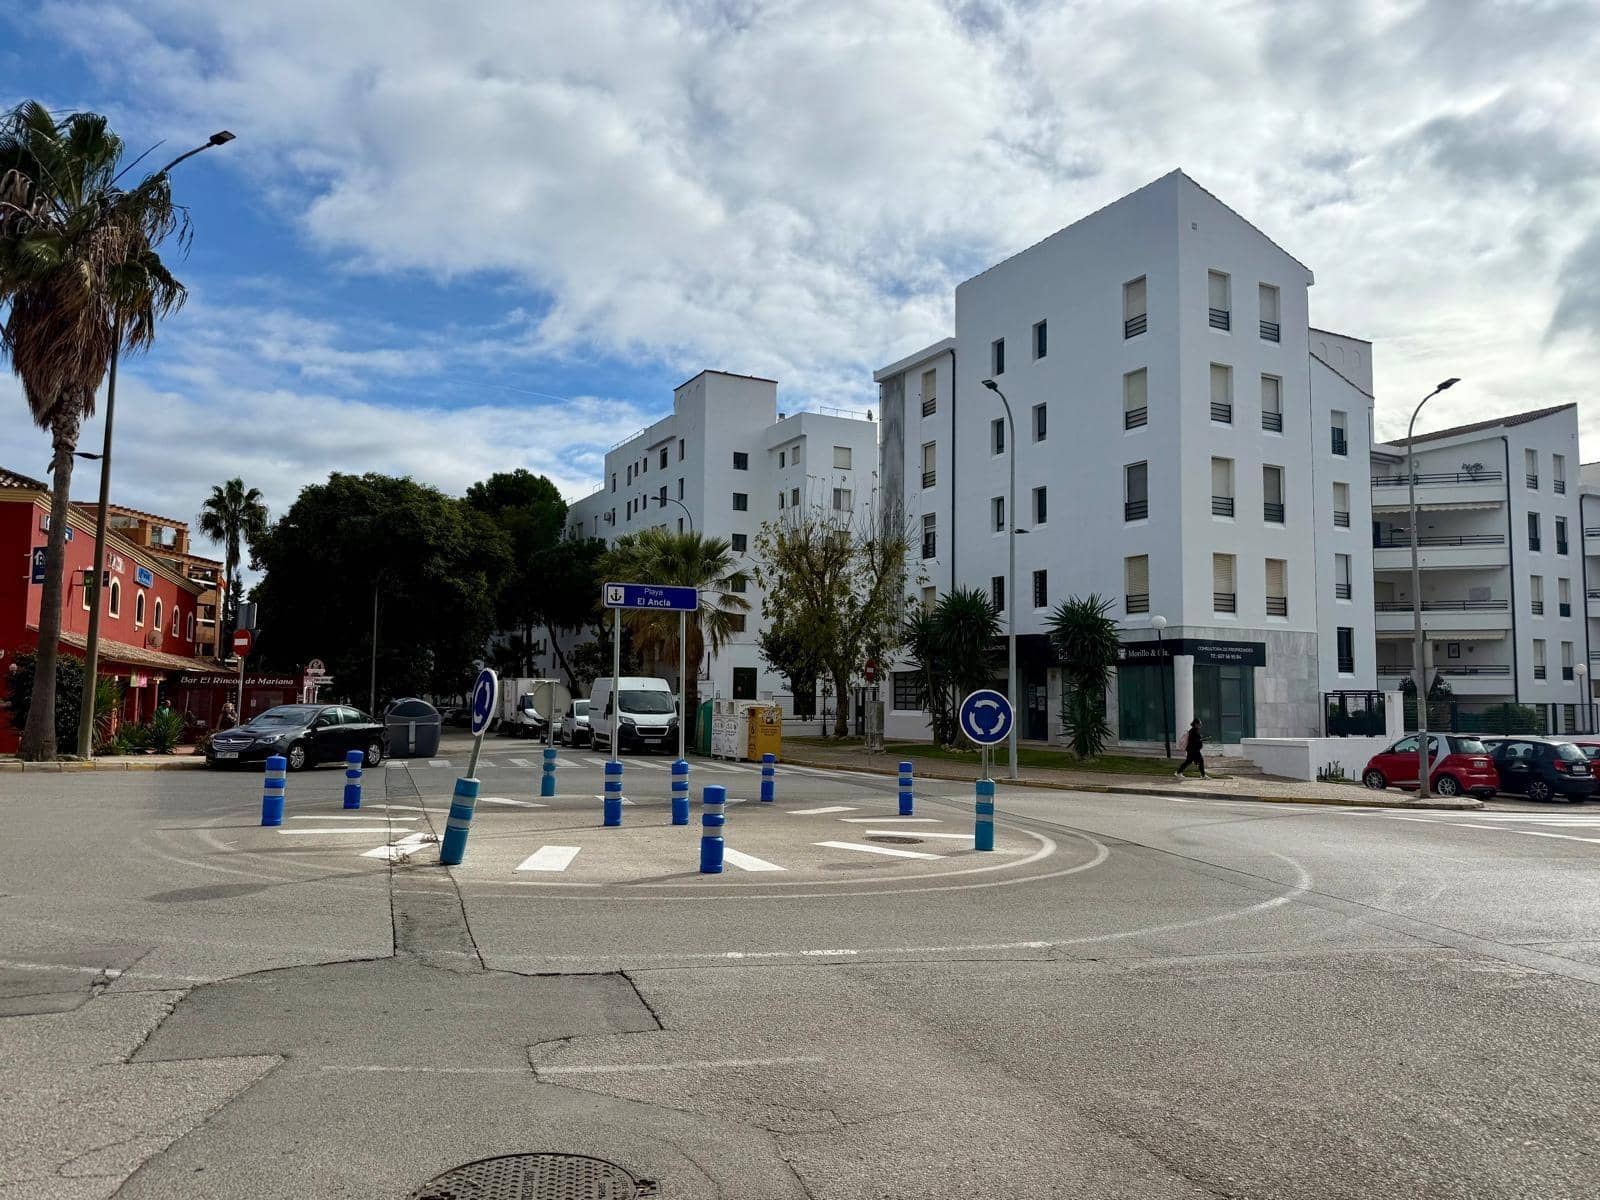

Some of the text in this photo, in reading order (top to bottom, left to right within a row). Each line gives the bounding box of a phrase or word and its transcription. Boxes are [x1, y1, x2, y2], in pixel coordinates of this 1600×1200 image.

[644, 588, 664, 597] Playa
[637, 597, 671, 607] El Ancla
[180, 676, 197, 684] Bar
[199, 676, 211, 684] El
[244, 677, 255, 685] de
[257, 677, 294, 685] Mariana
